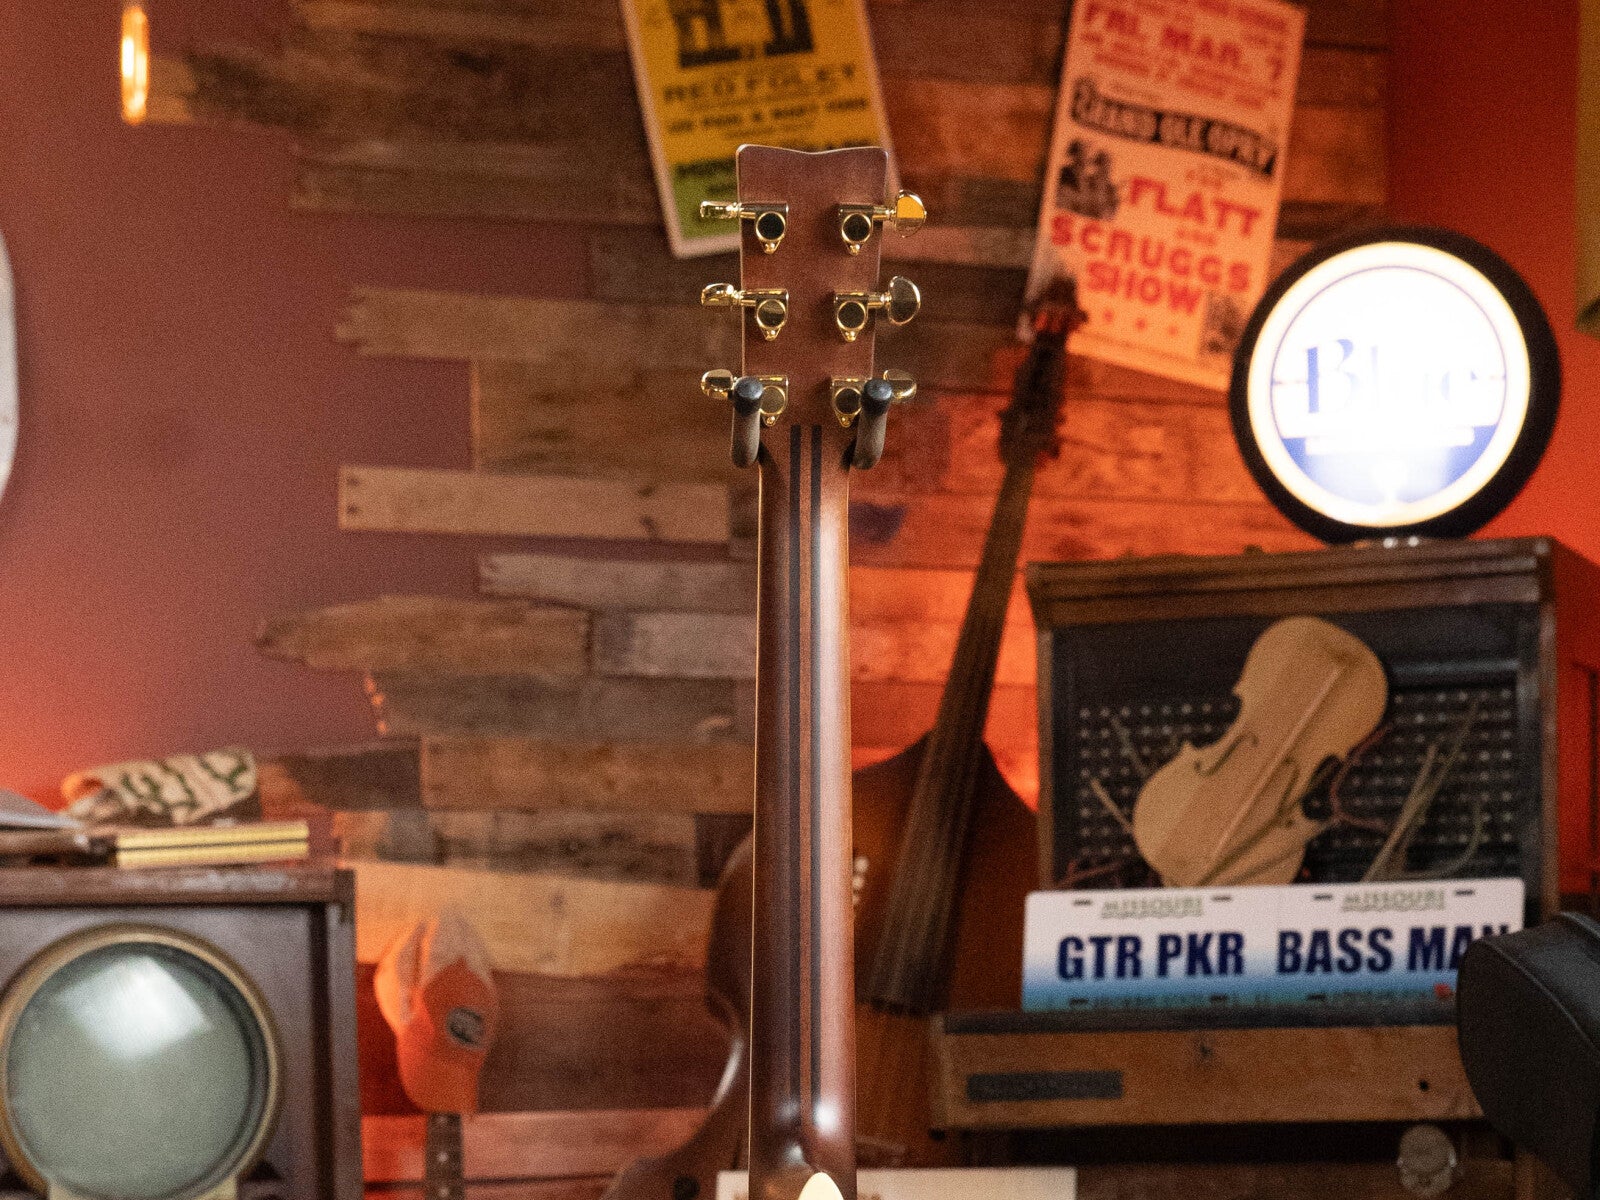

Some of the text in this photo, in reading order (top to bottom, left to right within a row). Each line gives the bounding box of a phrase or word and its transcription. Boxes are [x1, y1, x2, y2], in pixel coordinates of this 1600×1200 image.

[1129, 174, 1262, 238] FLATT
[1050, 213, 1252, 293] SCRUGGS
[1086, 260, 1203, 315] SHOW
[1056, 931, 1245, 981] GTR PKR
[1276, 923, 1510, 975] BASS MA
